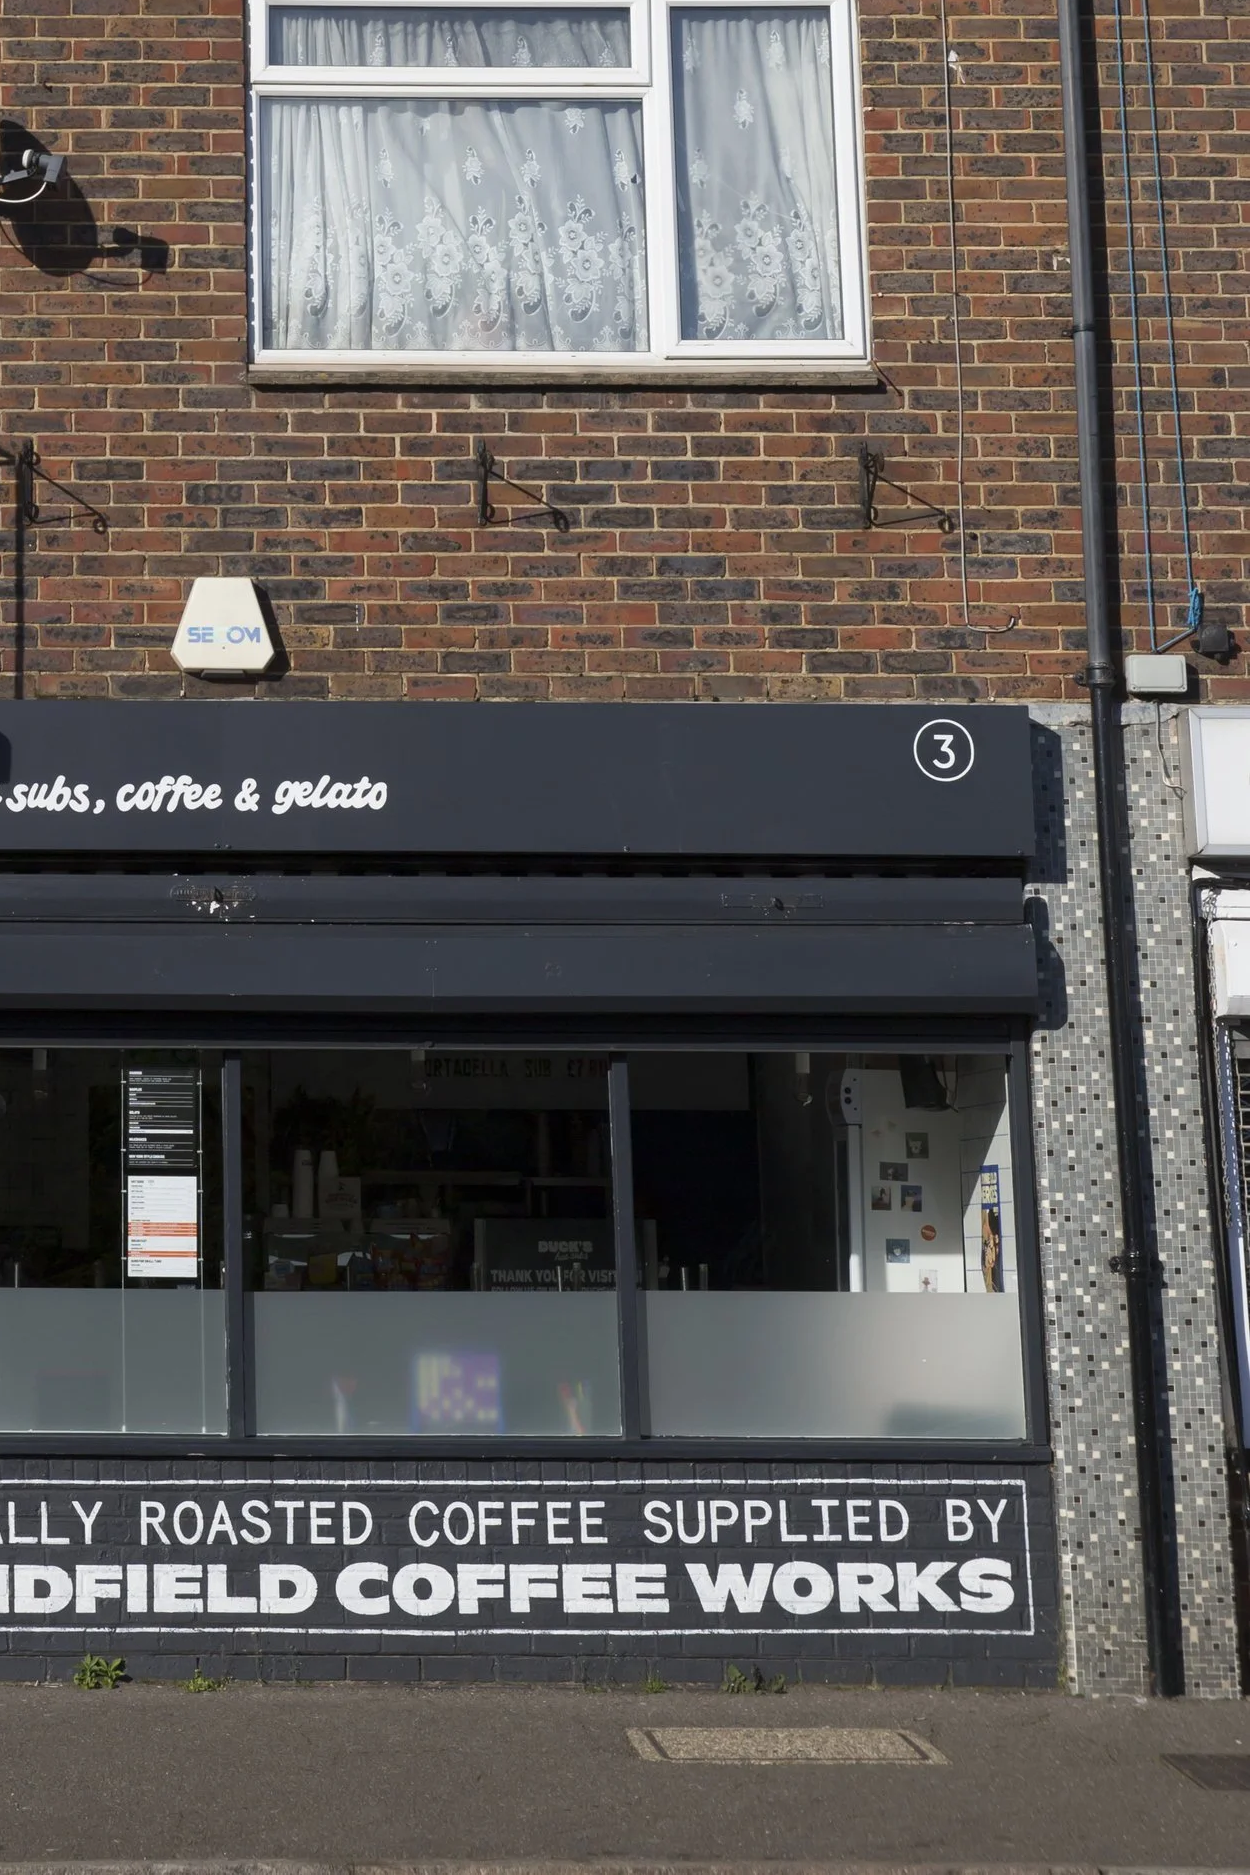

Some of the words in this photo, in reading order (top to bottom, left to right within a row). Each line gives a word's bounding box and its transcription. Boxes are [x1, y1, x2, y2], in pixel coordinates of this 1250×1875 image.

[187, 626, 261, 644] SEOM
[932, 734, 956, 769] 3
[6, 775, 105, 814] subs,
[116, 775, 223, 812] coffee
[234, 778, 261, 811] &
[271, 775, 388, 814] gelato
[538, 1241, 593, 1253] DUCK'S
[490, 1269, 533, 1283] THANK
[140, 1500, 373, 1546] ROASTED
[408, 1500, 609, 1547] COFFEE
[643, 1499, 909, 1544] SUPPLIED
[947, 1499, 1008, 1543] BY
[335, 1561, 670, 1616] COFFEE
[685, 1558, 1015, 1614] WORKS
